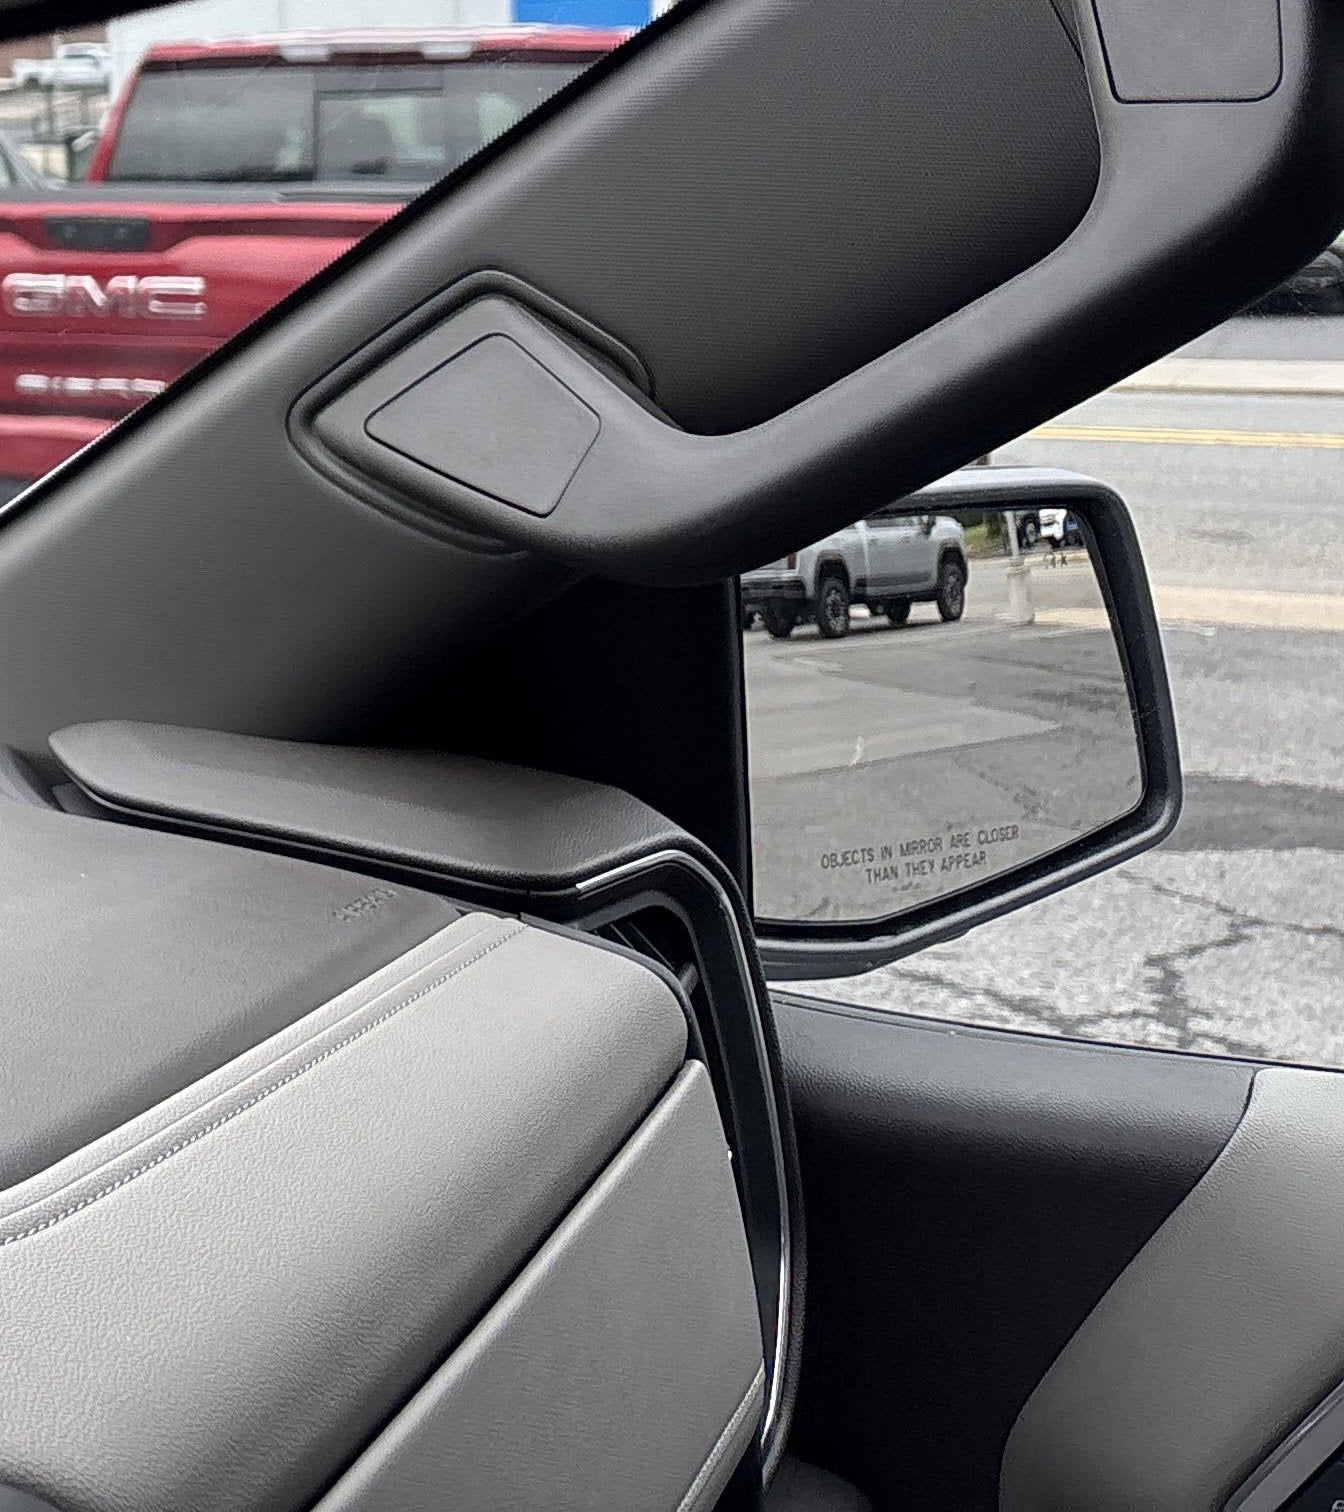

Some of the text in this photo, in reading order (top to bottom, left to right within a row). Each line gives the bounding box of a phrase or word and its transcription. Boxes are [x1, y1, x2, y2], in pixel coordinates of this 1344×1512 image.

[1, 272, 206, 320] GMC
[821, 824, 1020, 869] OBJECTS IN MIRROR ARE CLOSER
[866, 850, 987, 884] THAN THEY APPEAR
